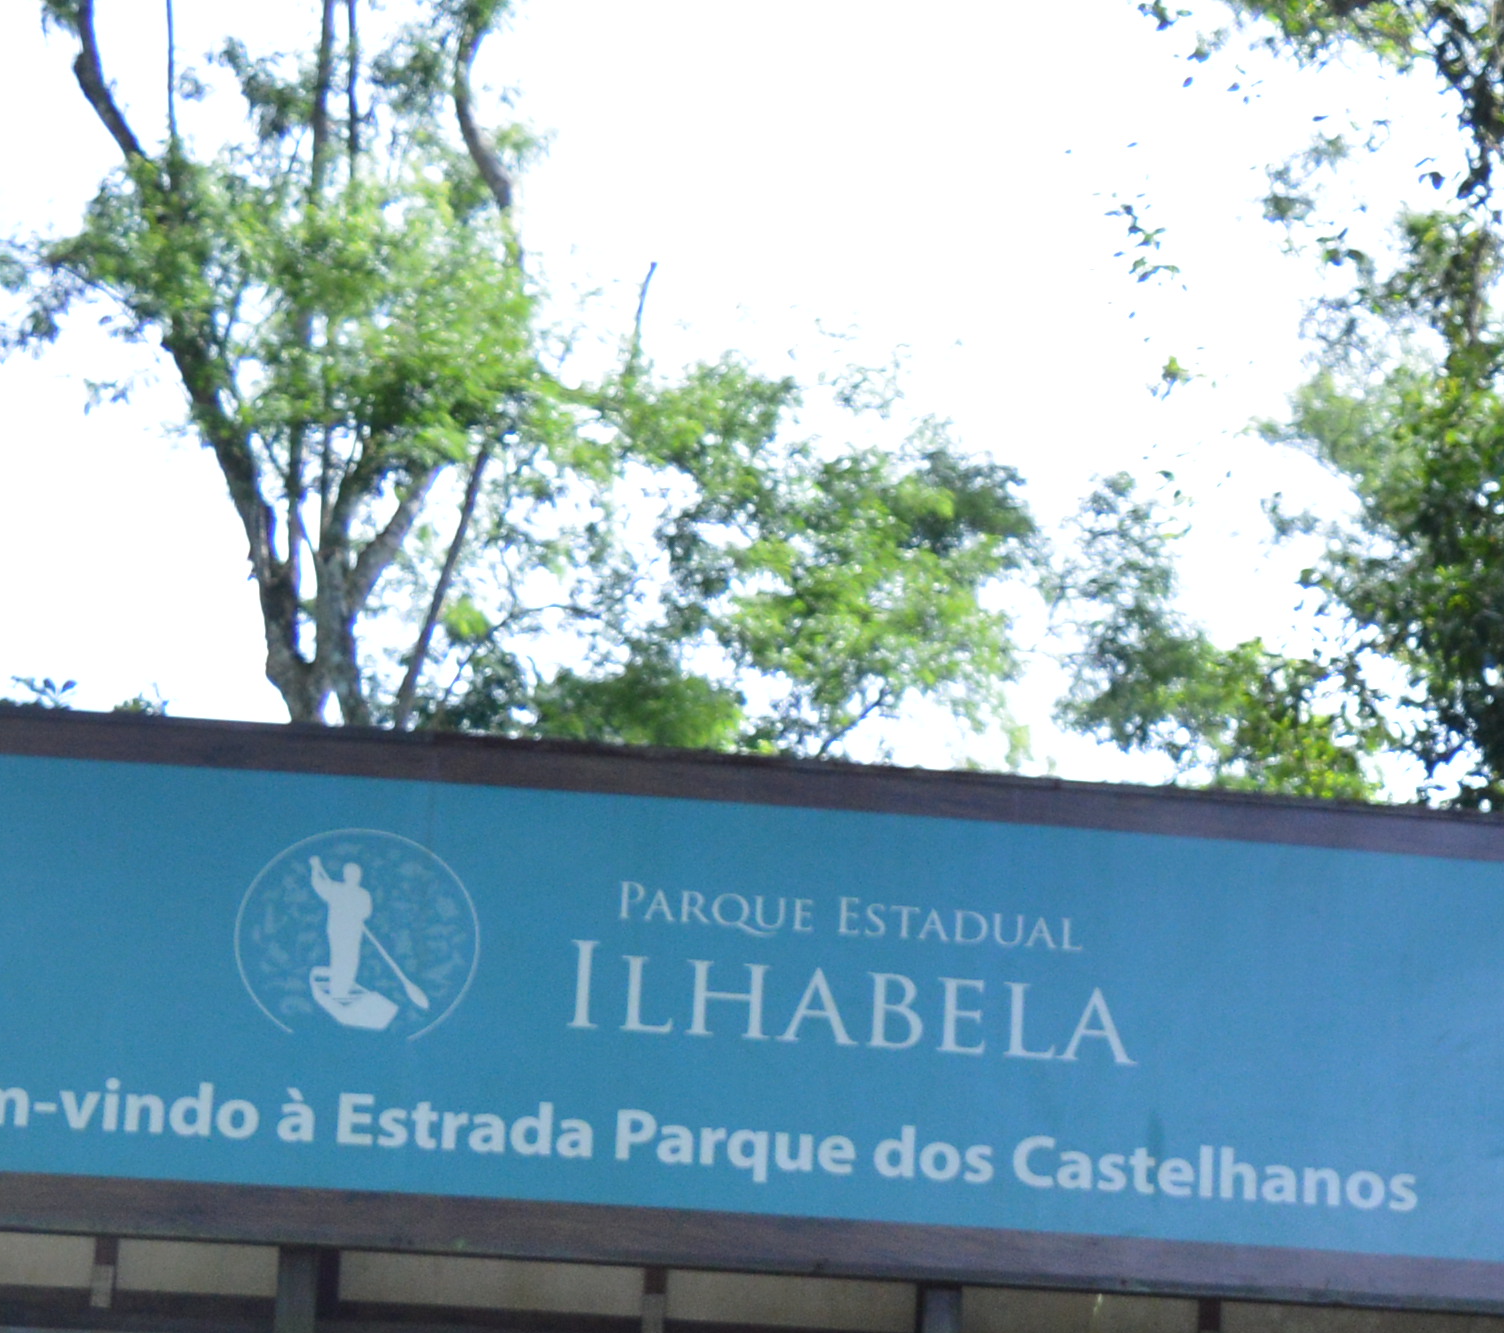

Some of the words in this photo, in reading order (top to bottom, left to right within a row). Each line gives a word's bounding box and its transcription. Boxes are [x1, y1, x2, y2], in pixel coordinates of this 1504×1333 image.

[276, 1087, 315, 1143] à
[336, 1092, 594, 1159] Estrada
[615, 1109, 857, 1184] Parque
[873, 1125, 994, 1184] dos
[1012, 1135, 1419, 1213] Castelhanos
